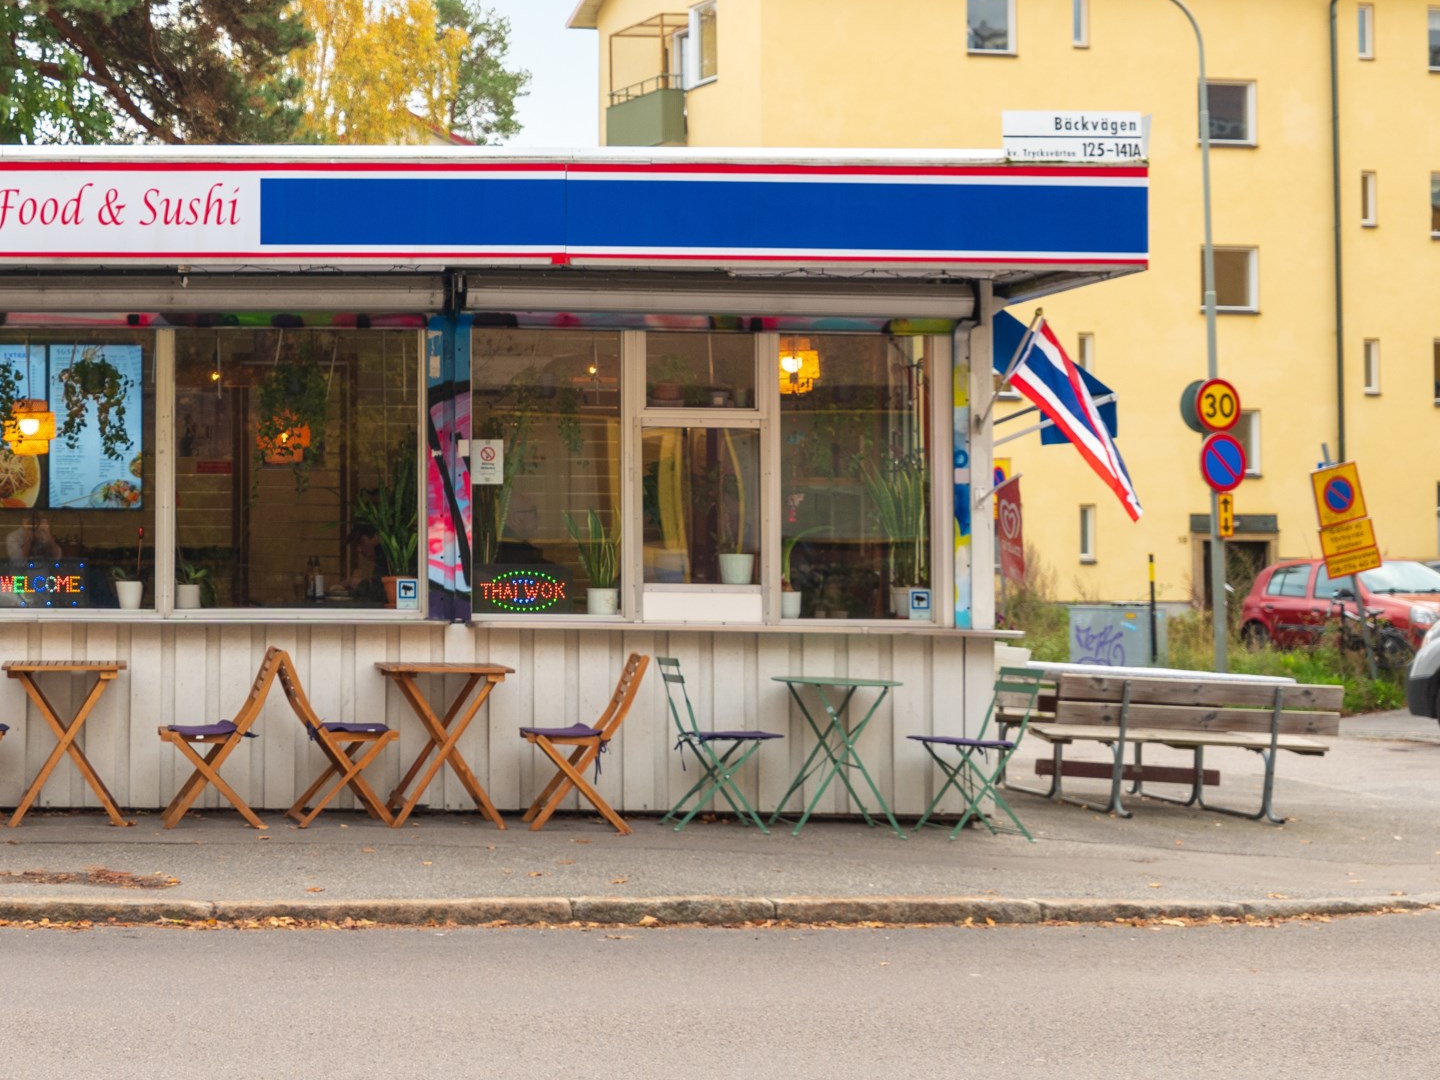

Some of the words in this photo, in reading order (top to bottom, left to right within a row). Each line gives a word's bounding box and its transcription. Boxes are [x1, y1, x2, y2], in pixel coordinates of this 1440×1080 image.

[1054, 116, 1137, 135] Bäckvägen
[97, 188, 126, 226] &
[138, 182, 242, 226] Sushi
[1204, 393, 1234, 418] 30
[0, 575, 81, 593] WELCOME
[480, 582, 518, 600] THAI
[524, 582, 566, 600] WOK
